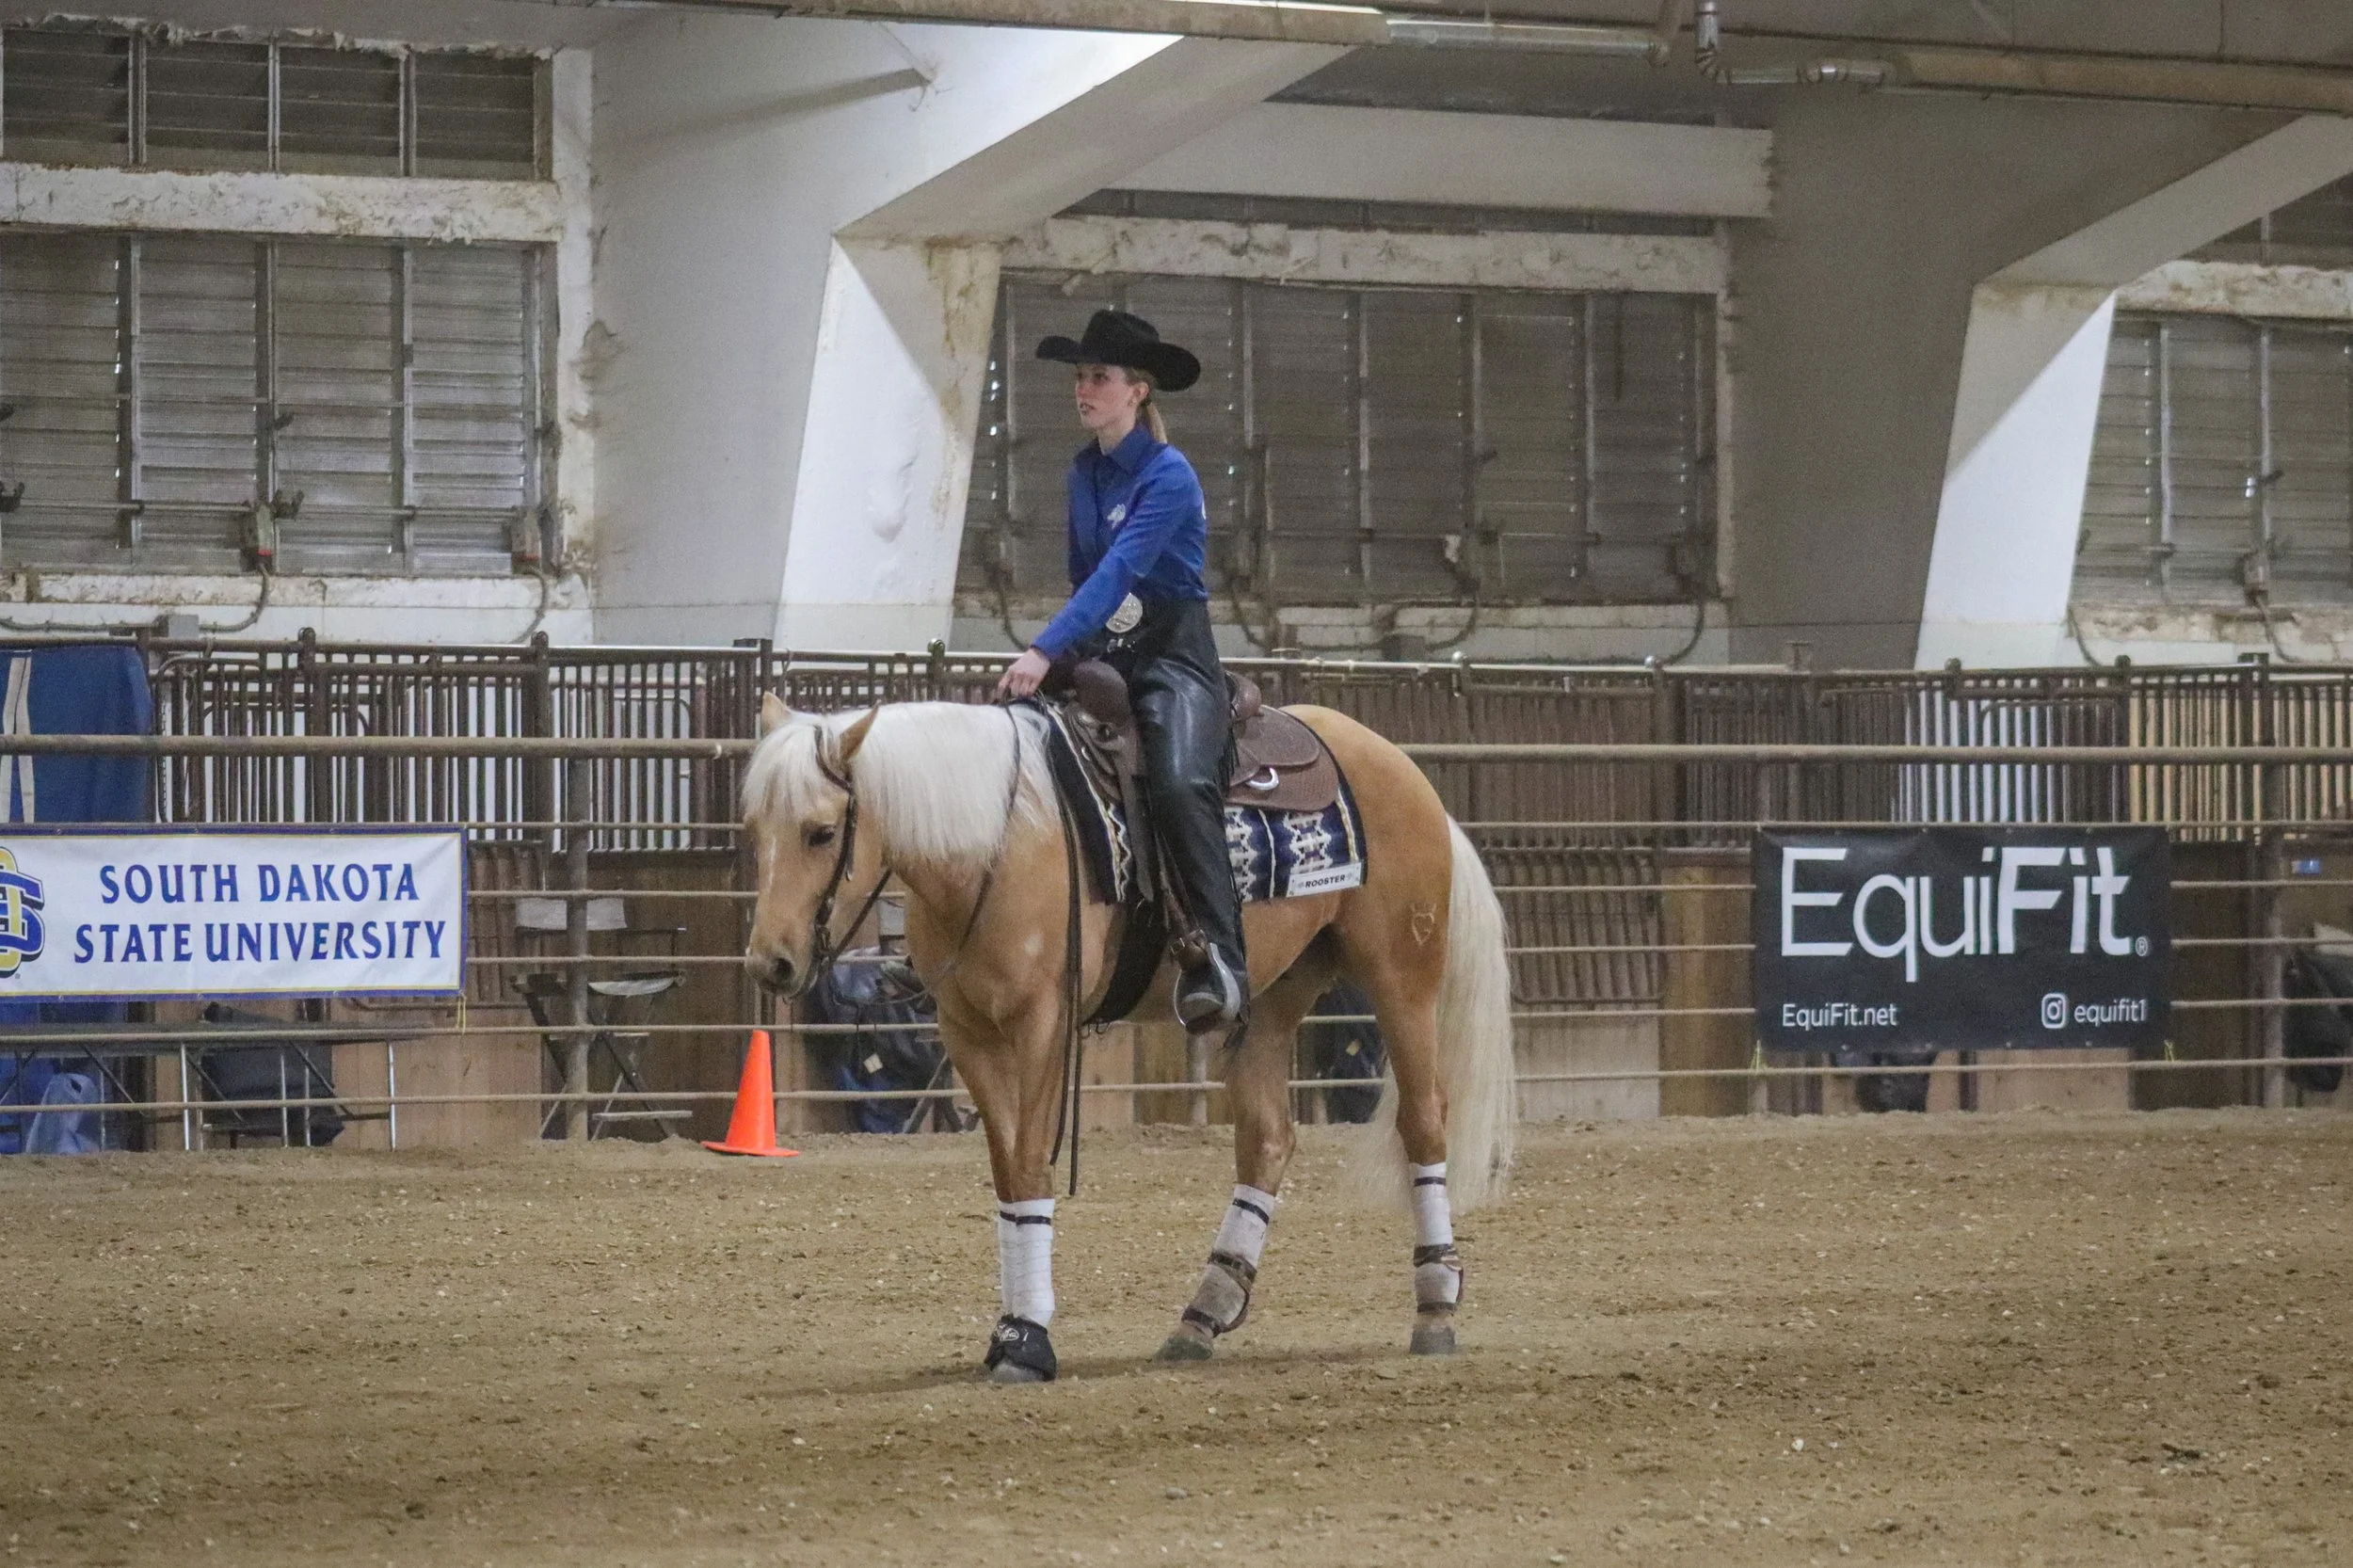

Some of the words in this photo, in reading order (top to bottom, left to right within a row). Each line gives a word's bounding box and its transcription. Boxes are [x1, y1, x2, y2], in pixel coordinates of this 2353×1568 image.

[100, 862, 238, 904] SOUTH
[259, 863, 421, 903] DAKOTA
[1305, 874, 1346, 888] ROOSTER
[73, 922, 193, 964] STATE
[204, 920, 447, 962] UNIVERSITY
[1782, 1002, 1898, 1031] EquiFit.net
[2073, 998, 2147, 1027] equifit1
